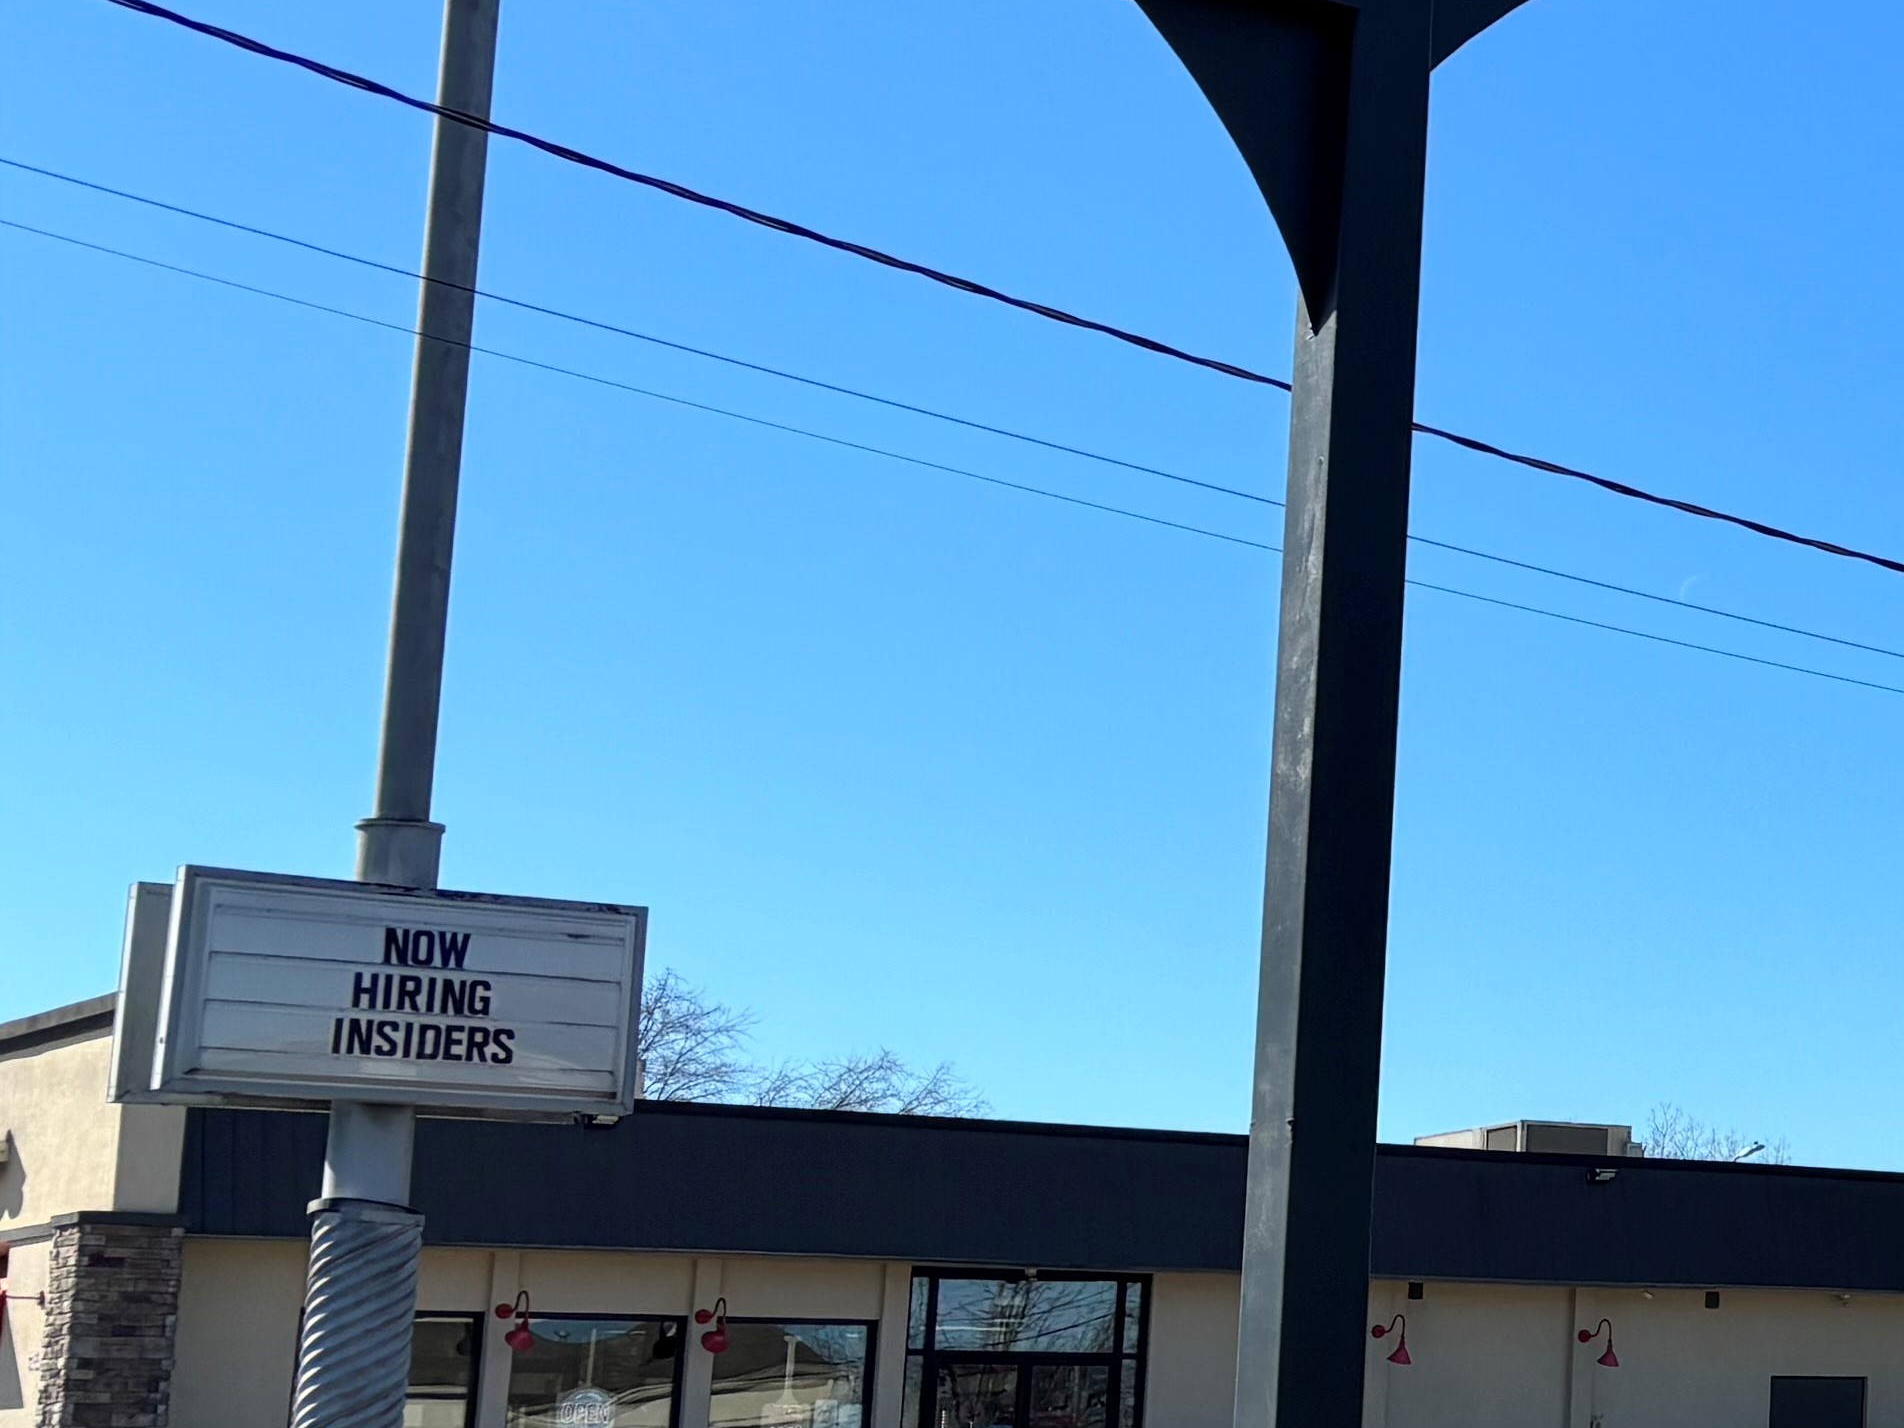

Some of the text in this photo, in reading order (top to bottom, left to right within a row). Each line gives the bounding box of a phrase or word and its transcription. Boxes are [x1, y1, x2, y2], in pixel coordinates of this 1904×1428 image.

[381, 926, 471, 969] NOW
[351, 972, 491, 1016] HIRING
[331, 1018, 516, 1065] INSIDERS
[560, 1402, 609, 1424] OPEN
